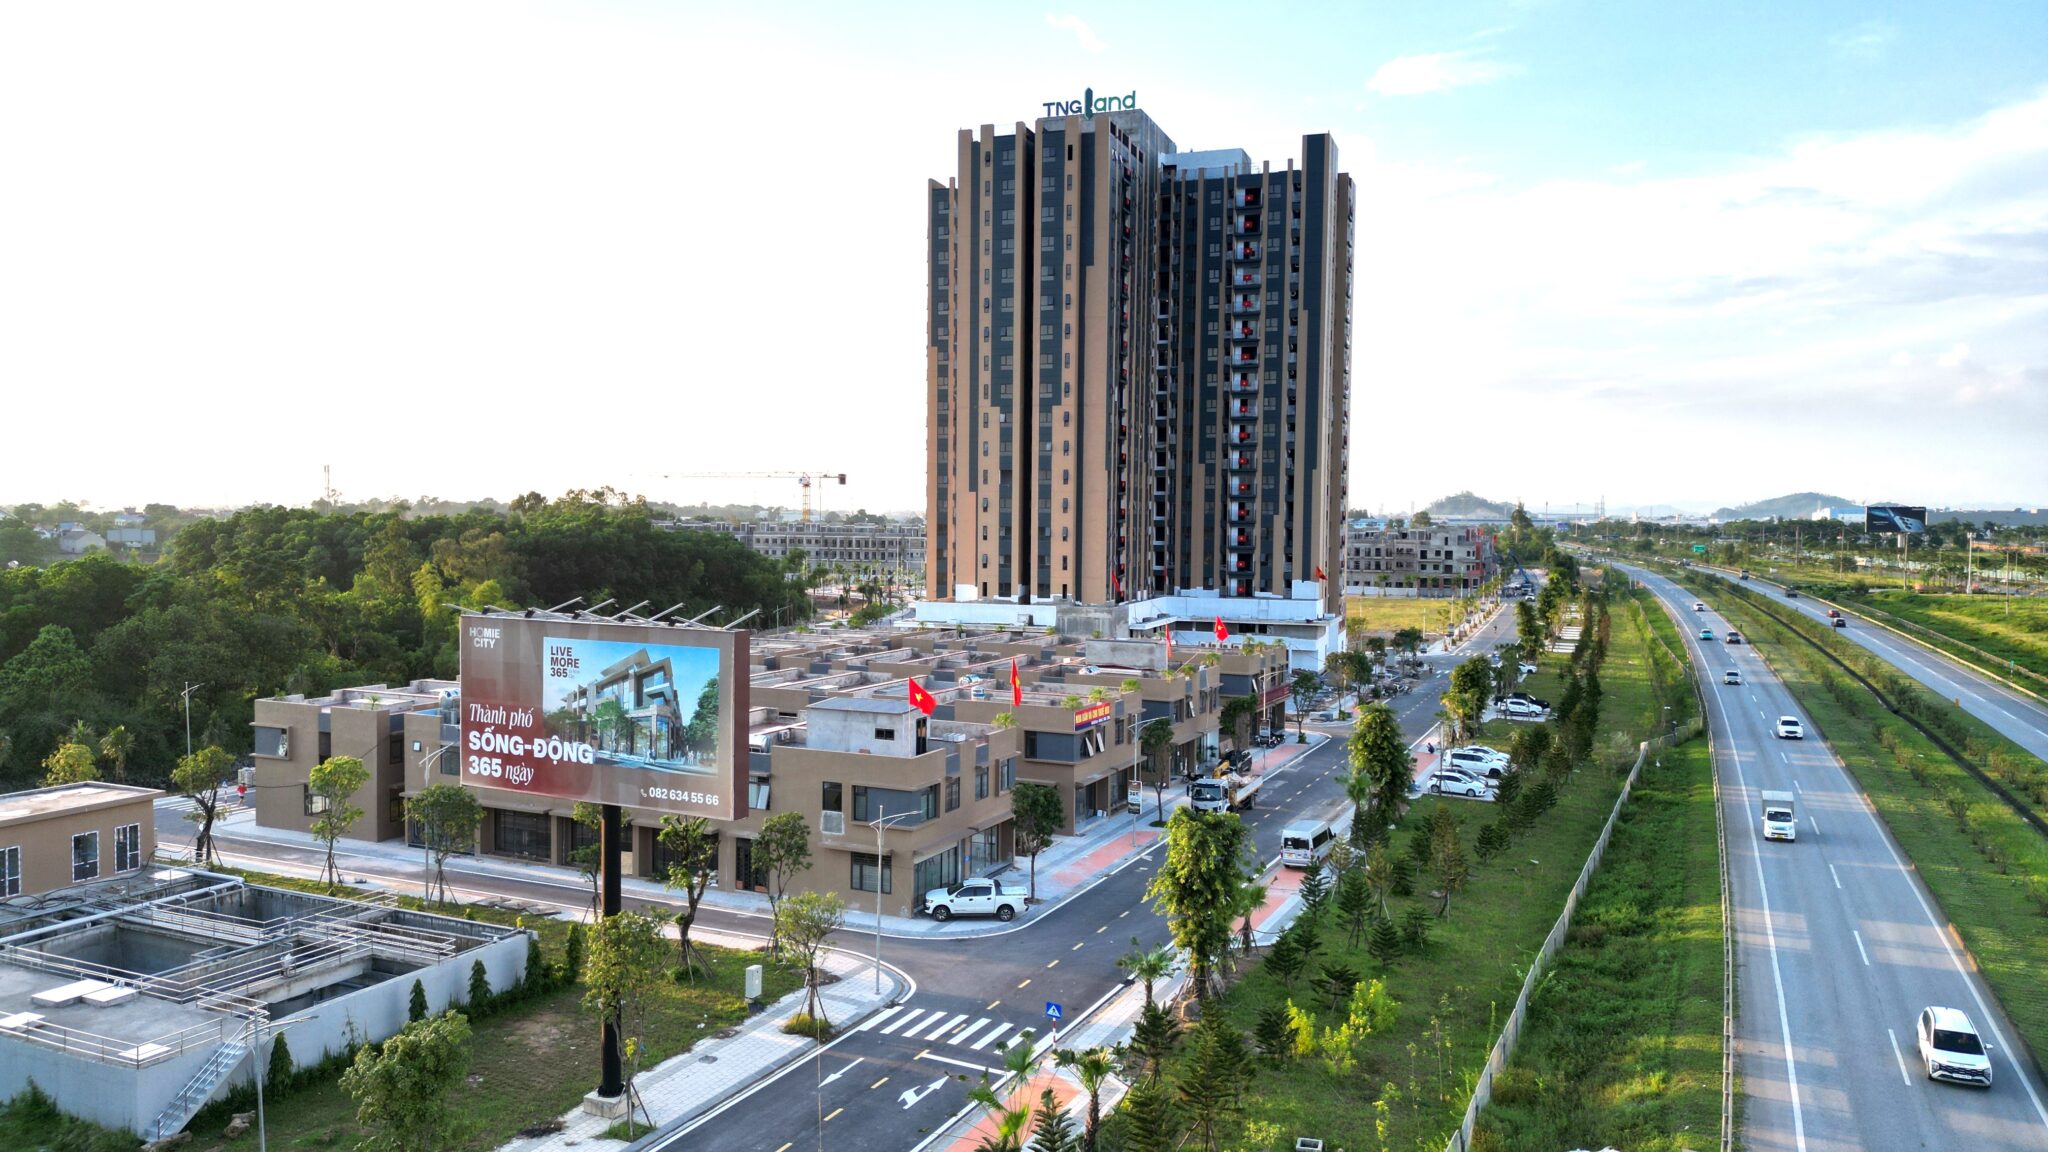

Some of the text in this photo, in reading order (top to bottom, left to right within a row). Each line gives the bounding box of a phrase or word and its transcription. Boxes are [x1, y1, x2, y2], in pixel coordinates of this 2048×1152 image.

[1043, 100, 1083, 118] TNG
[469, 626, 501, 639] HOMIE
[473, 637, 496, 649] CITY
[550, 645, 573, 657] LIVE
[550, 656, 580, 669] MORE
[550, 667, 568, 678] 365
[469, 703, 534, 730] Thành phố
[468, 725, 594, 765] SỐNG-ĐỘNG
[468, 755, 534, 786] 365 ngày
[649, 786, 719, 806] 082 634 55 66
